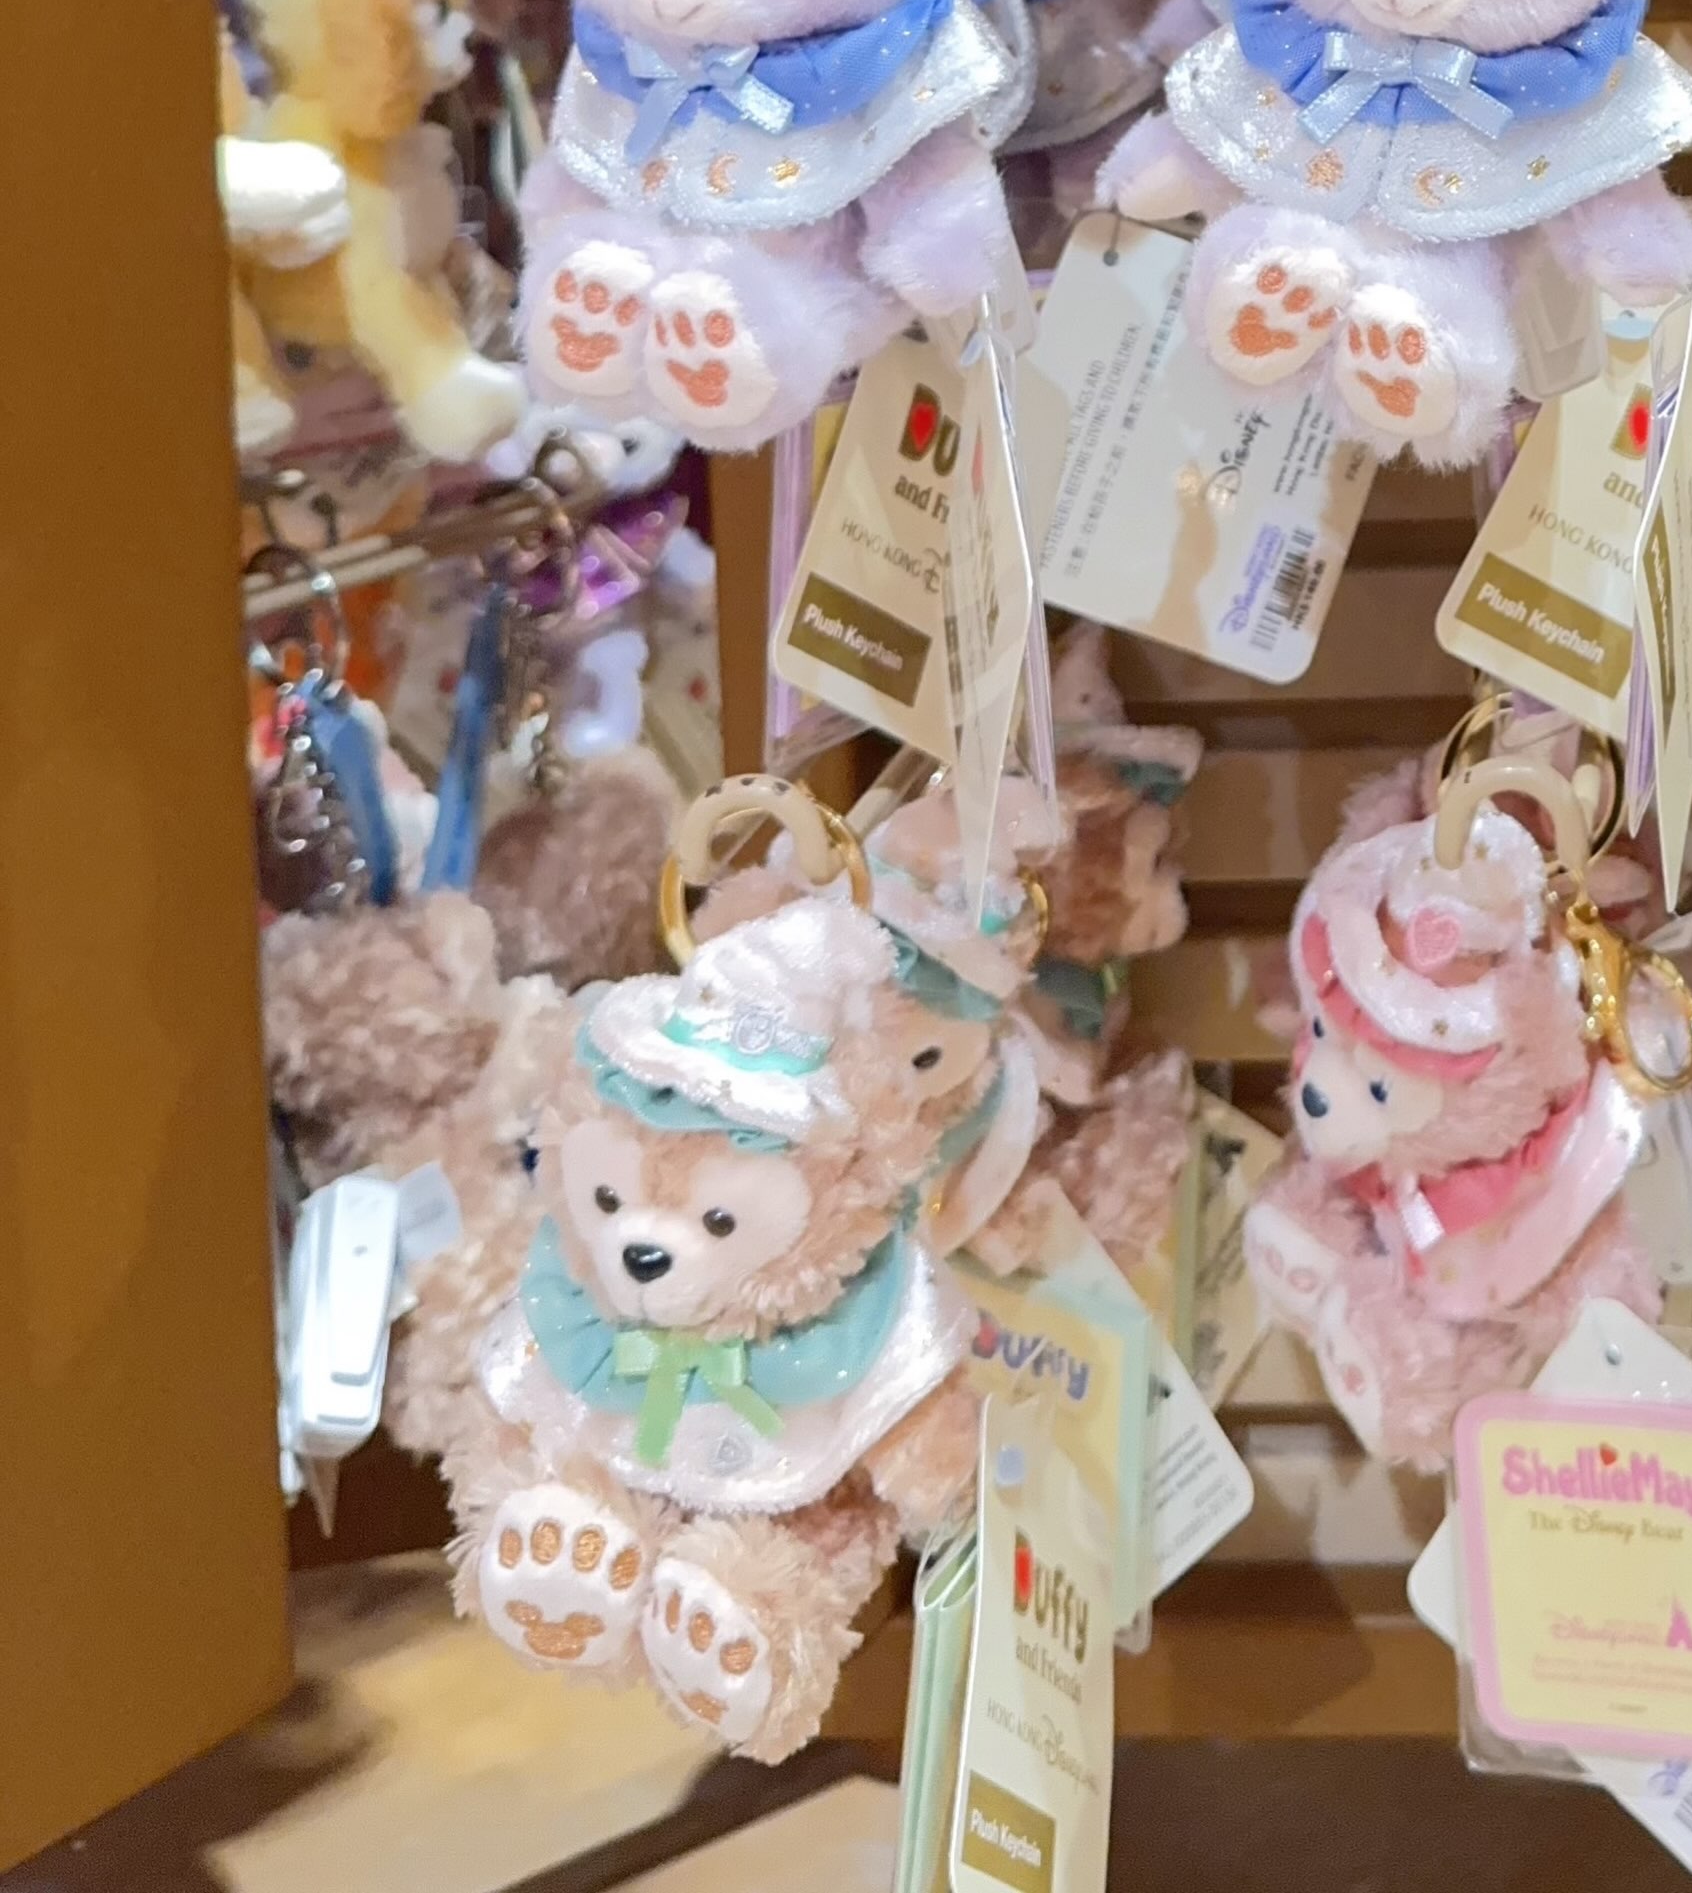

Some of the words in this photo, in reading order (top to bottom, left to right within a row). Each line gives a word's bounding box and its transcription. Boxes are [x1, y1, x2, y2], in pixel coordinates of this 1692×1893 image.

[894, 474, 932, 510] and
[1528, 504, 1585, 546] HONG
[803, 603, 844, 639] Plush
[842, 619, 904, 672] Keychain
[1477, 582, 1527, 622] Plush
[1528, 609, 1606, 664] Keychain
[1528, 1510, 1561, 1530] The
[1562, 1505, 1634, 1543] Disney
[1014, 1525, 1089, 1664] Duffy
[1016, 1637, 1038, 1668] and
[971, 1809, 998, 1842] Plush
